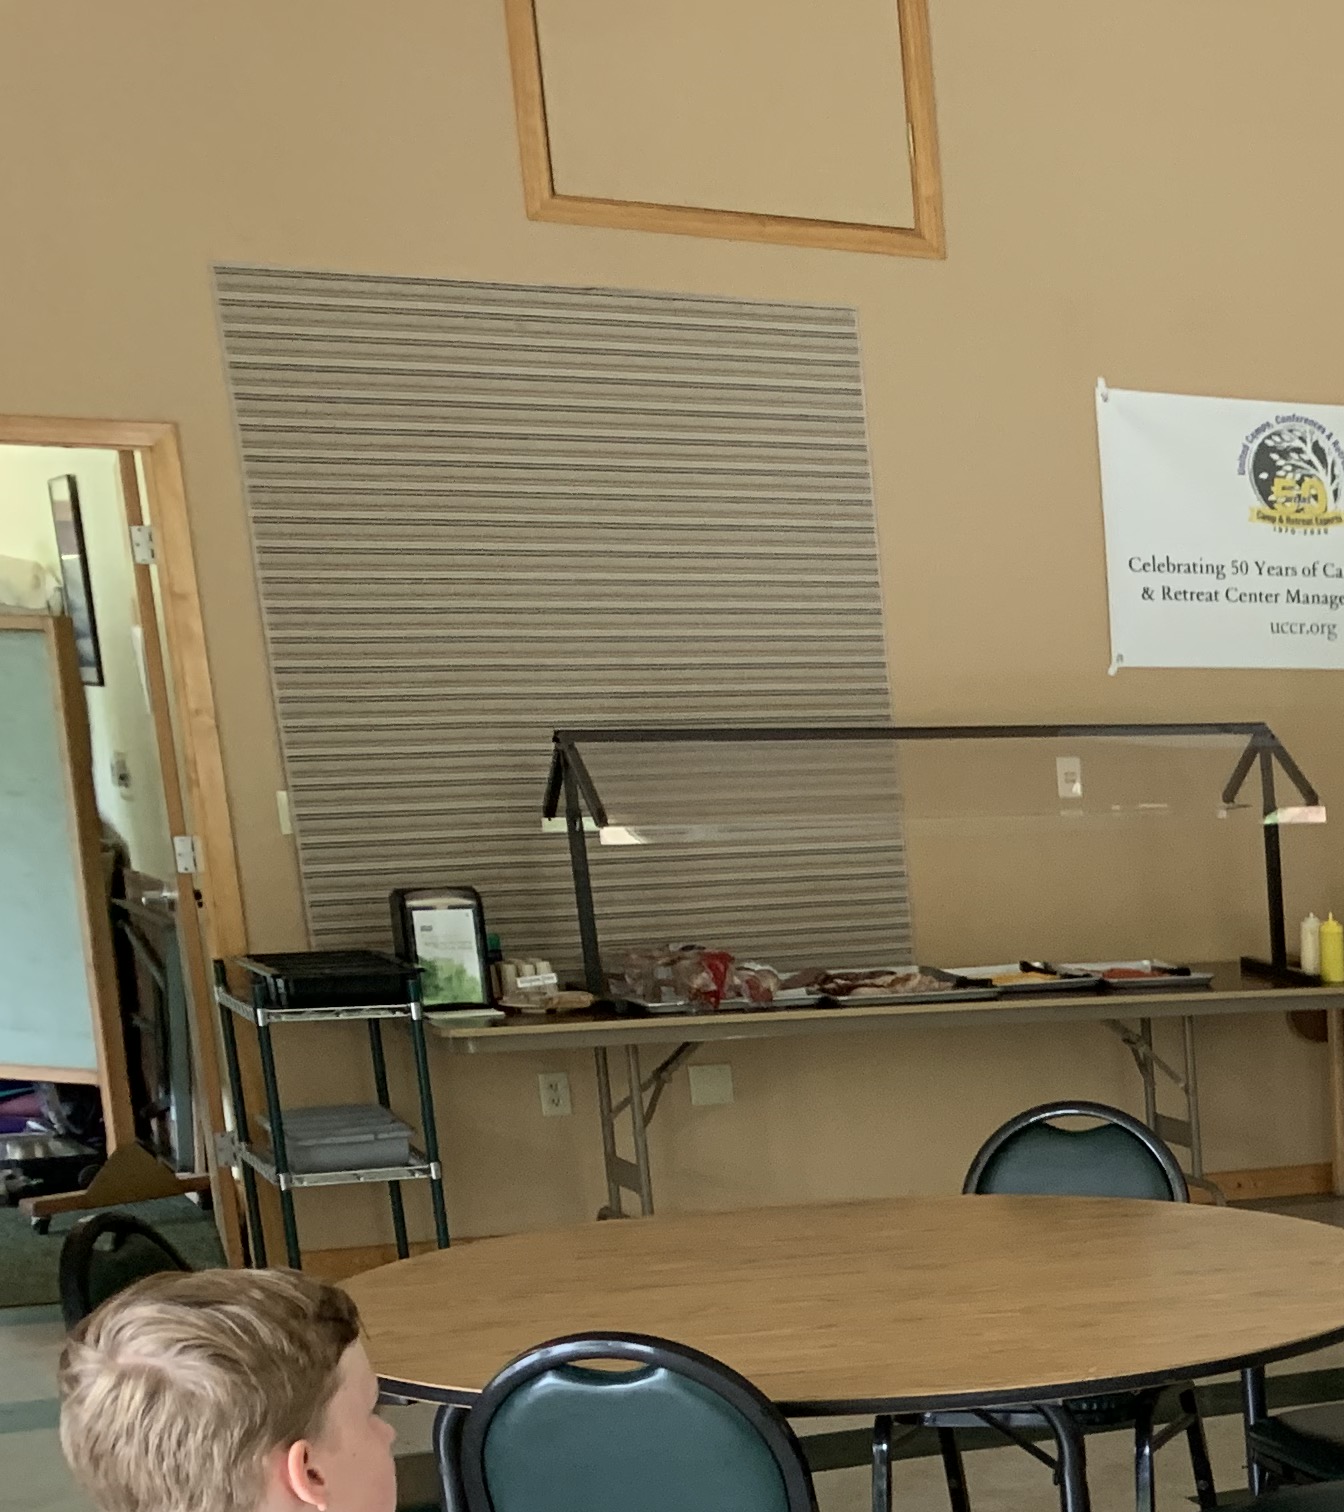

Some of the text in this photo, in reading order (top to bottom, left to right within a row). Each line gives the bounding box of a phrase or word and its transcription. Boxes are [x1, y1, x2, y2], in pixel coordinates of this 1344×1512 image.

[1275, 413, 1327, 434] Conferences
[1272, 476, 1327, 513] 50
[1128, 554, 1226, 580] Celebrating
[1231, 560, 1249, 576] 50
[1254, 560, 1298, 577] Years
[1301, 560, 1320, 578] of
[1141, 586, 1155, 602] &
[1161, 585, 1219, 602] Retreat
[1225, 587, 1280, 604] Center
[1270, 621, 1338, 642] uccr.org
